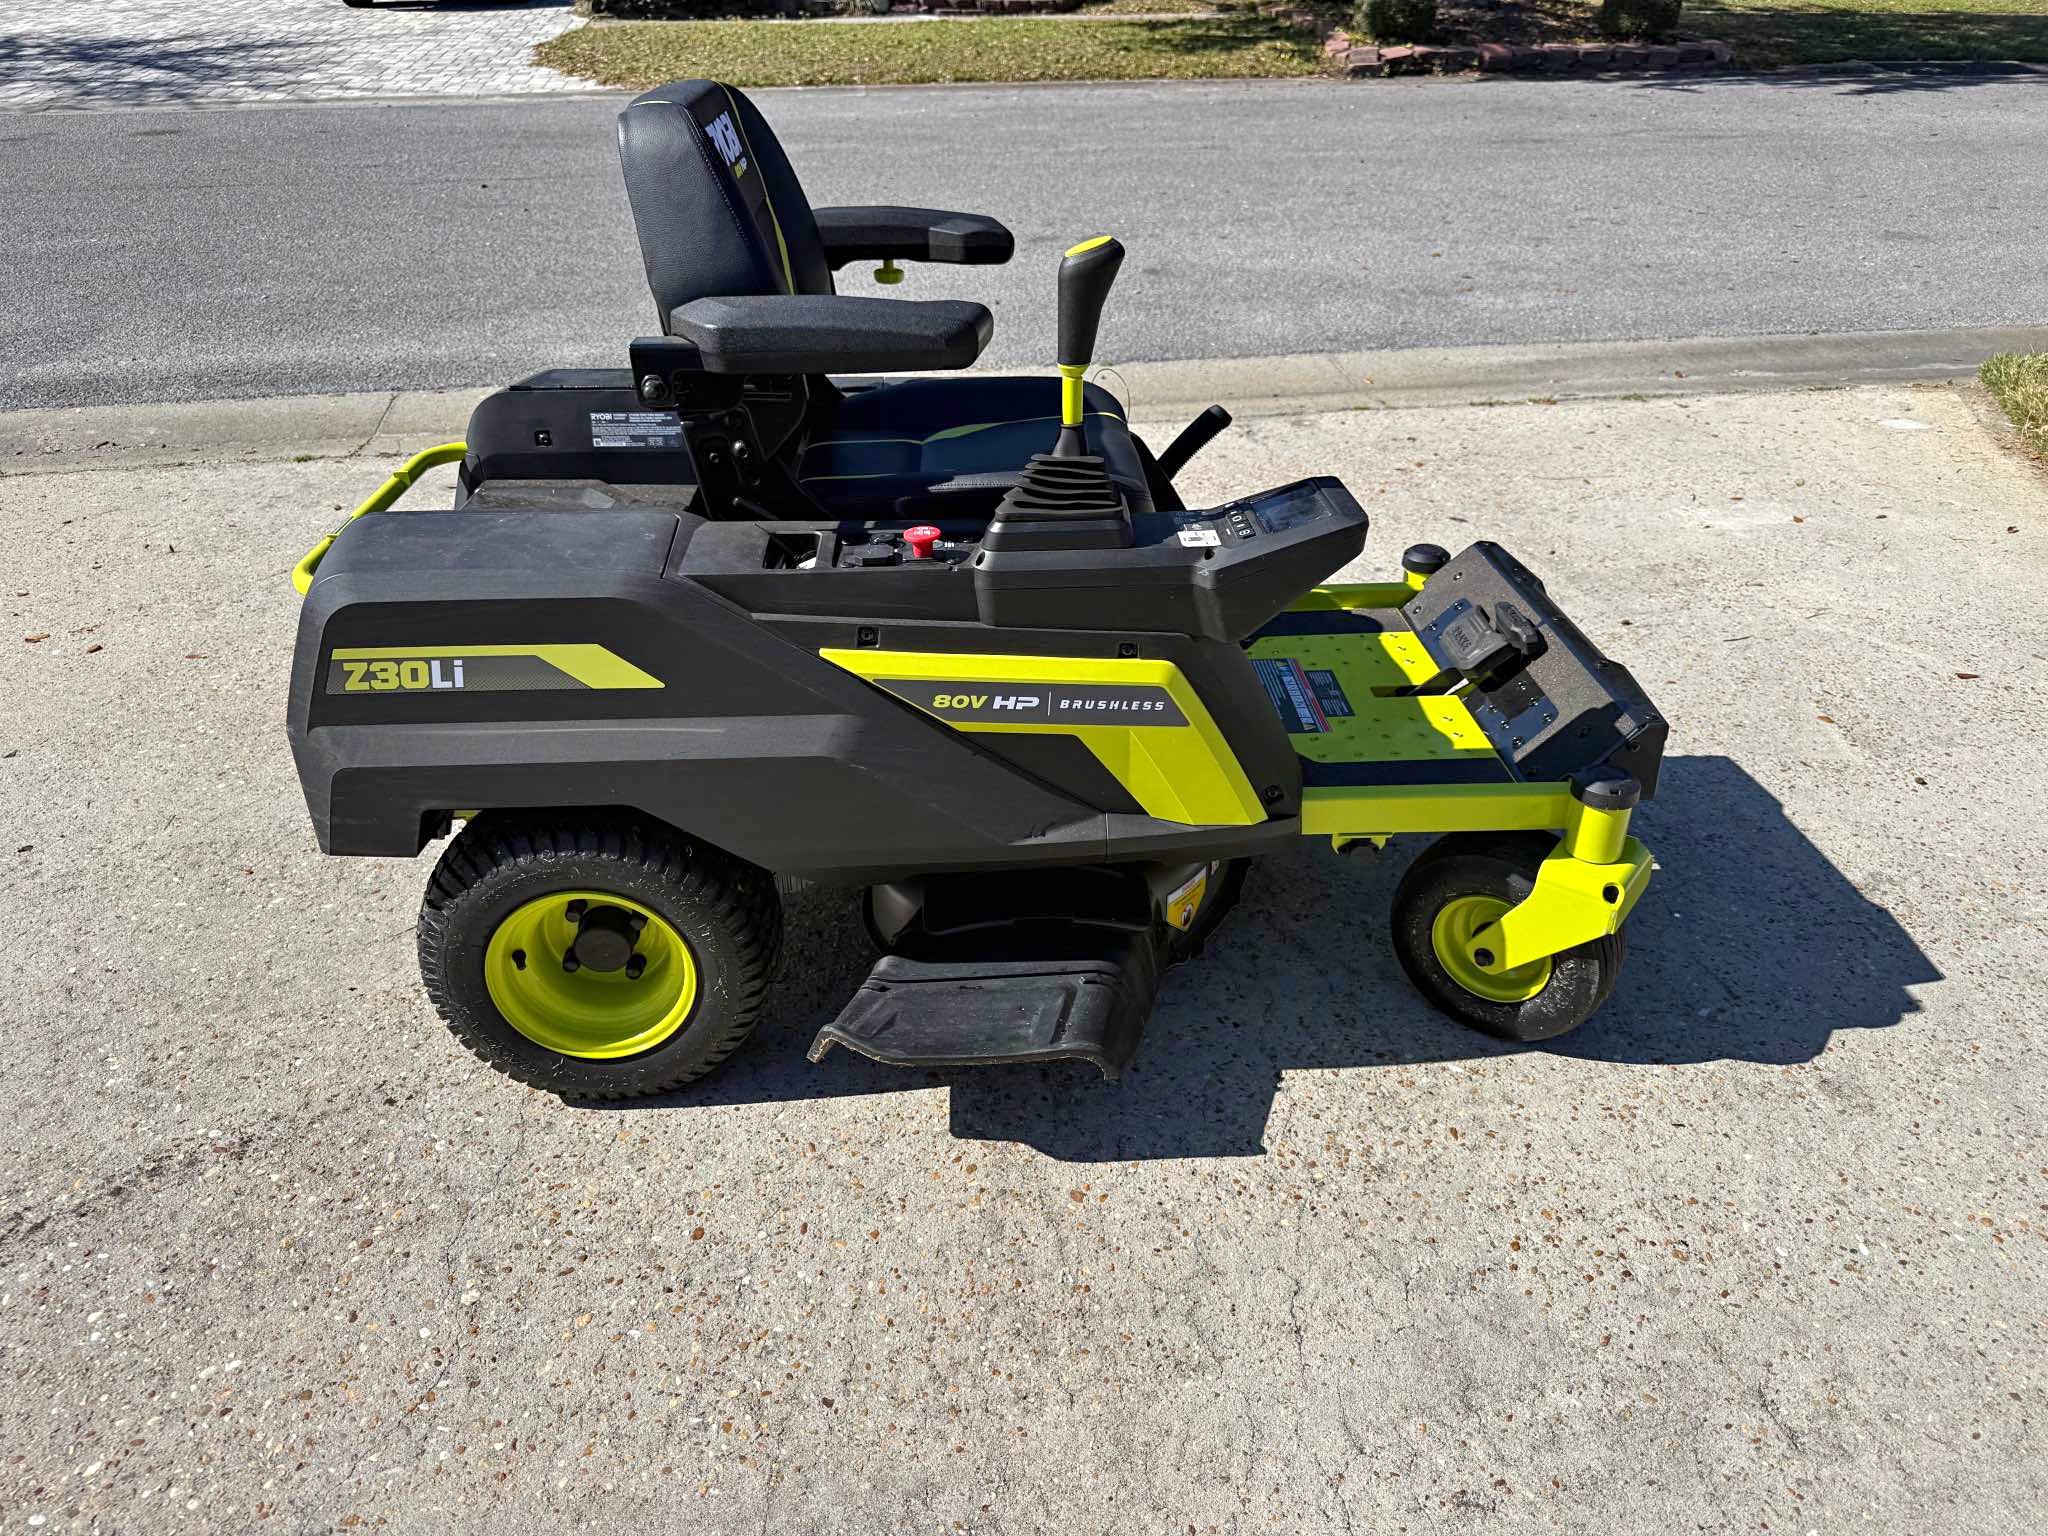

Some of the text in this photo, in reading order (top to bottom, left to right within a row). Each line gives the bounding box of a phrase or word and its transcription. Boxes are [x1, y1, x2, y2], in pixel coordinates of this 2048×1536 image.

[342, 659, 465, 691] Z30Li
[932, 694, 1166, 711] 80V HP BRUSHLESS
